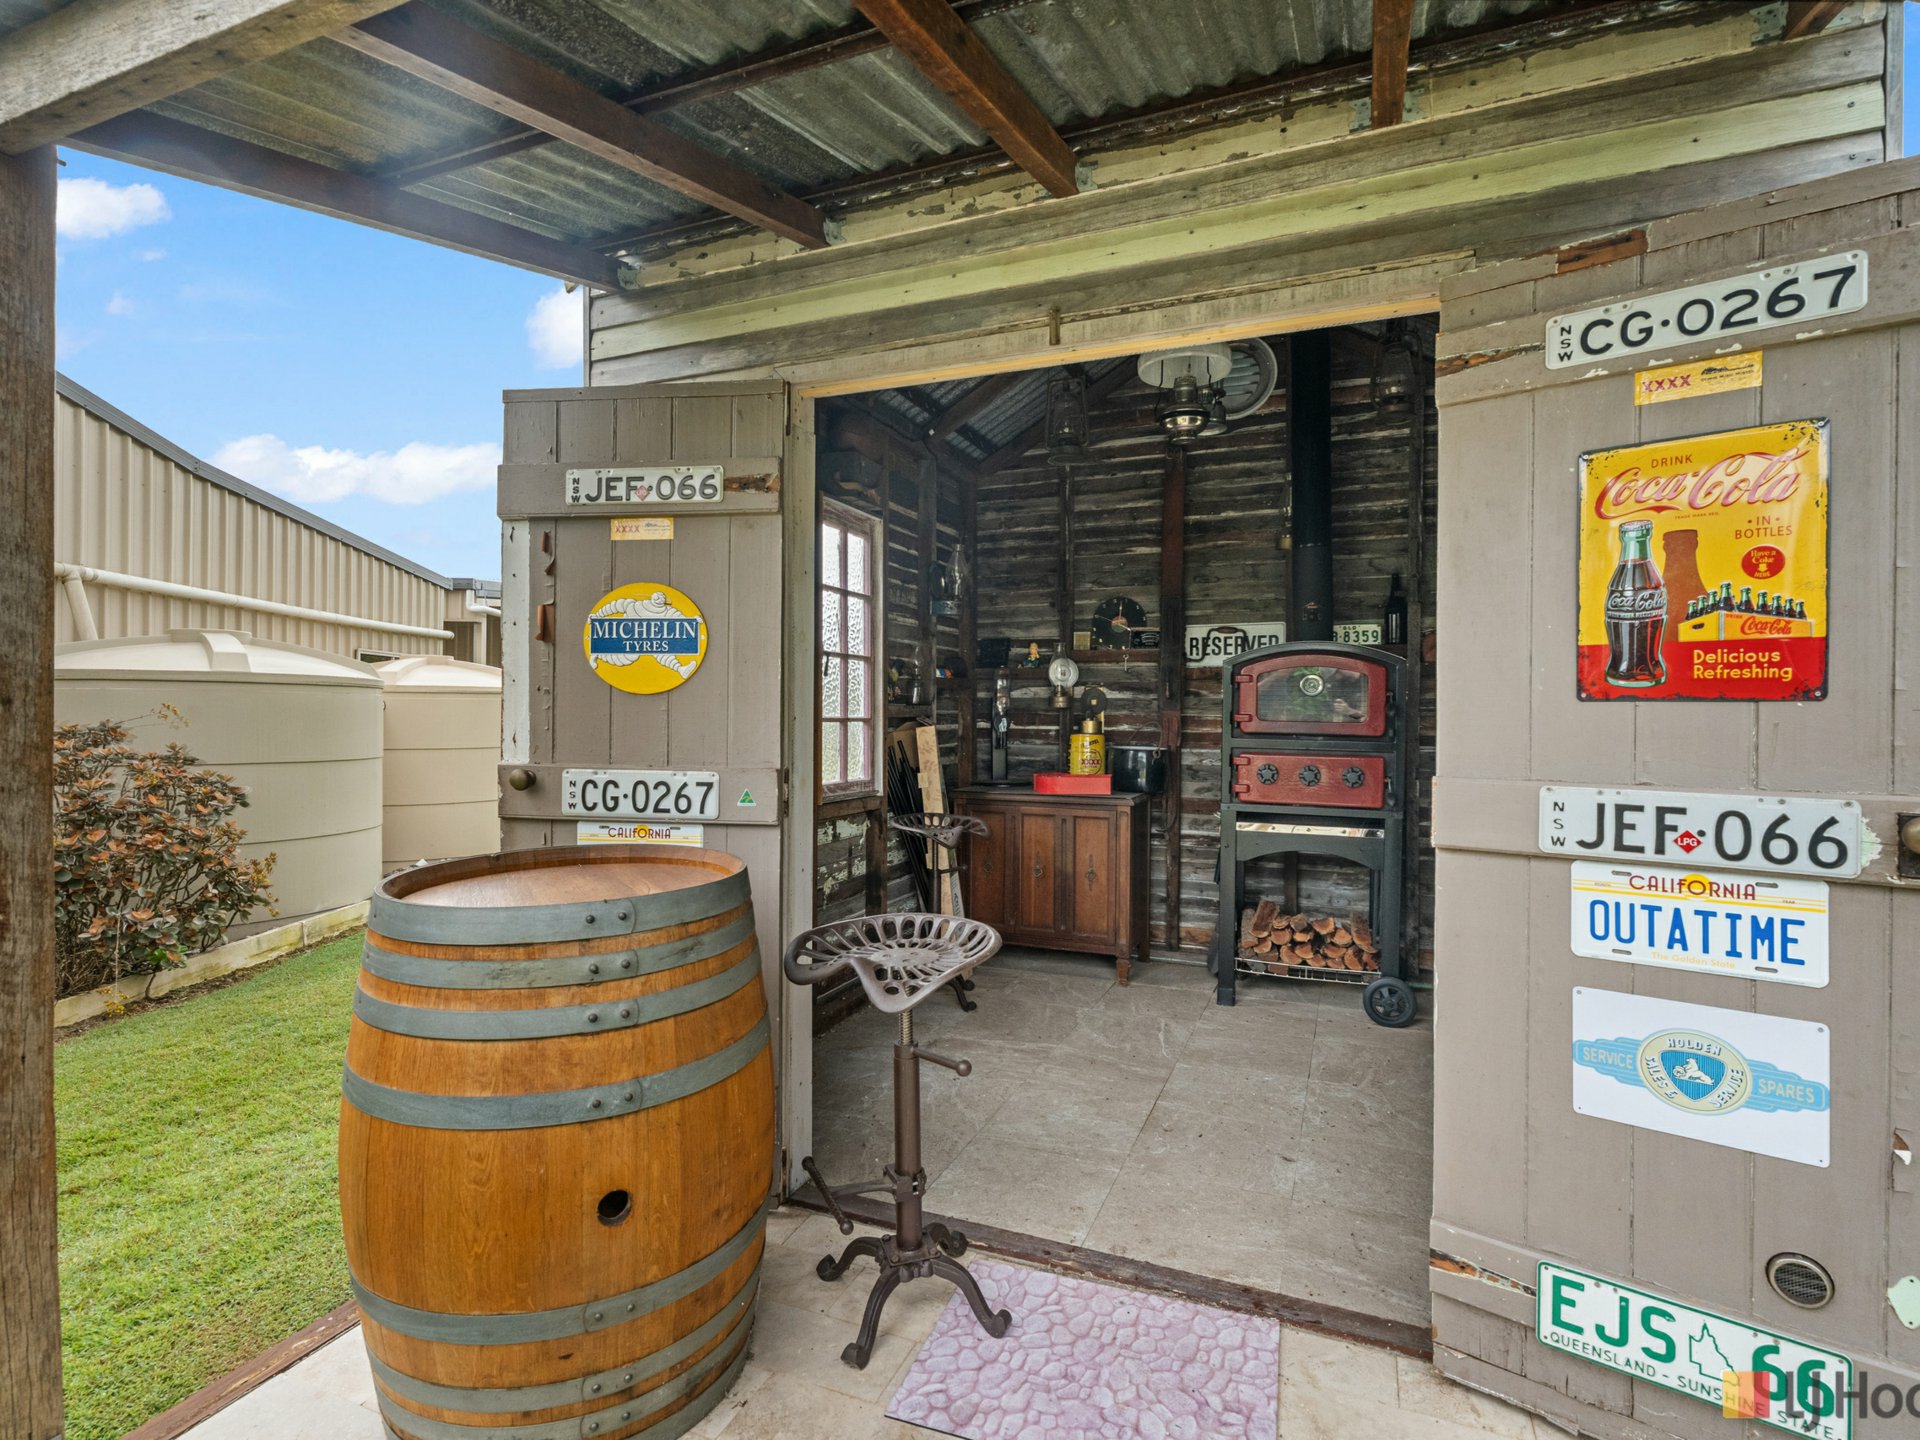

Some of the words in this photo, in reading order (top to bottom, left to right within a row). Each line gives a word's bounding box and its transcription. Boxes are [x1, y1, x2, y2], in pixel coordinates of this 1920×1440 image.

[1558, 324, 1573, 362] NSW
[1642, 373, 1691, 392] XXXX
[1651, 453, 1694, 468] DRINK
[571, 477, 581, 503] NSW
[1594, 448, 1810, 519] Coca-Cola
[1735, 525, 1793, 540] BOTTLES
[592, 621, 698, 639] MICHELIN
[1740, 616, 1793, 636] Coca-Cola
[623, 640, 669, 652] TYRES
[1693, 648, 1781, 664] Delicious
[1693, 664, 1793, 682] Refreshing
[568, 780, 577, 810] NSW
[608, 827, 671, 839] CALIFORNIA
[1550, 801, 1567, 847] NSW
[1677, 837, 1698, 847] LPG
[1629, 875, 1756, 901] CALIFORNIA
[1589, 899, 1806, 966] OUTATIME
[1651, 952, 1669, 961] The
[1672, 954, 1708, 966] Golden
[1711, 959, 1736, 969] State
[1667, 1038, 1722, 1056] HOLDEN
[1583, 1047, 1633, 1069] SERVICE
[1645, 1055, 1669, 1089] SALES
[1708, 1069, 1744, 1108] SERVICE
[1758, 1079, 1815, 1104] SPARES
[1552, 1275, 1676, 1364] EJS
[1752, 1345, 1834, 1417] 66
[1550, 1332, 1656, 1378] QUEENSLAND
[1677, 1375, 1767, 1417] SUNSHINE
[1777, 1410, 1834, 1440] STATE
